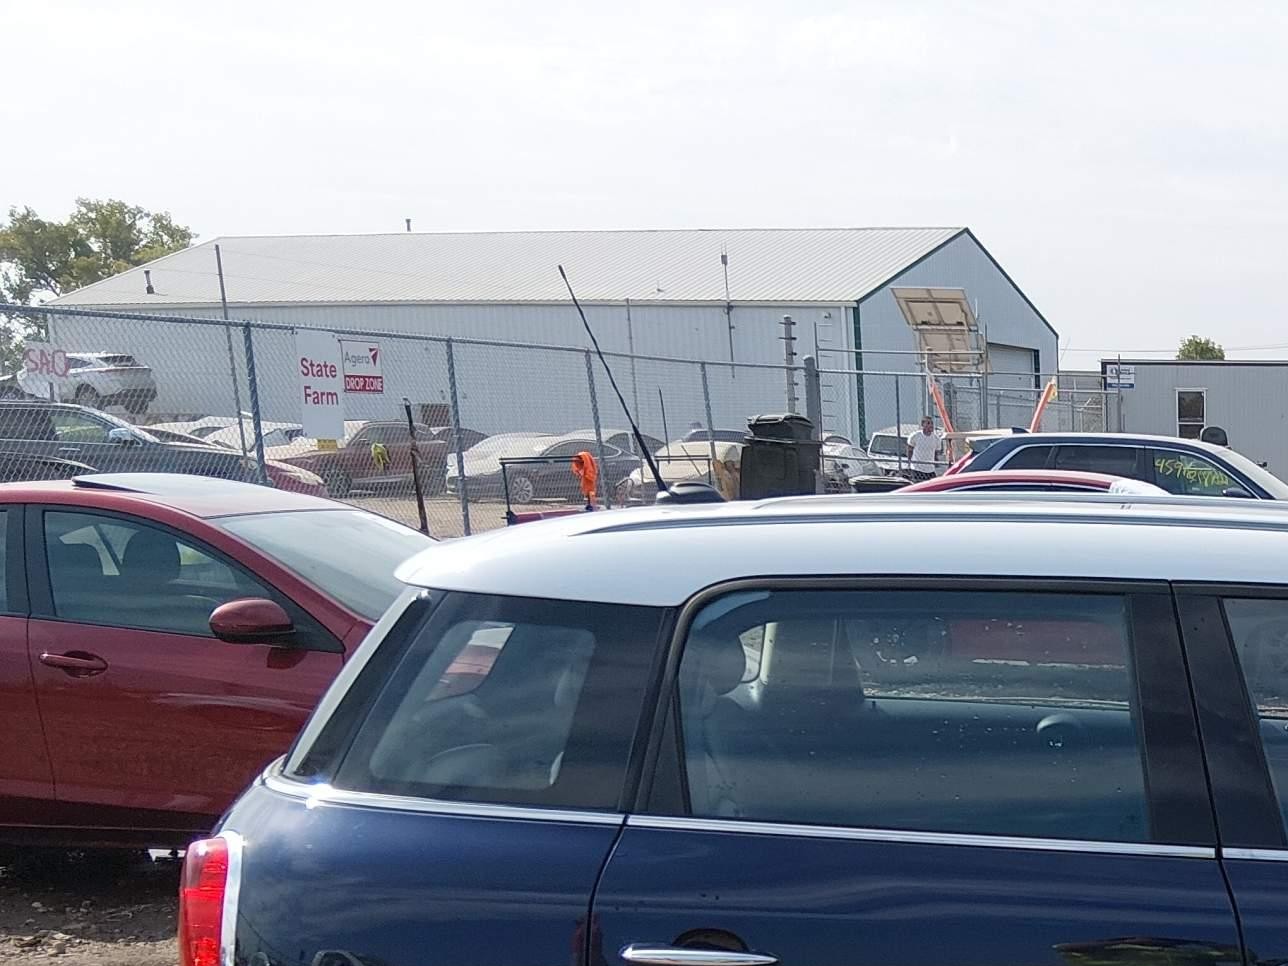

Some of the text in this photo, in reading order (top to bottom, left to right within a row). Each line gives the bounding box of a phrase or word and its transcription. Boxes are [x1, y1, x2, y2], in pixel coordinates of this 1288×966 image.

[300, 357, 337, 378] State
[344, 352, 369, 367] Agero
[345, 377, 383, 391] DROP ZONE
[303, 386, 339, 405] Farm
